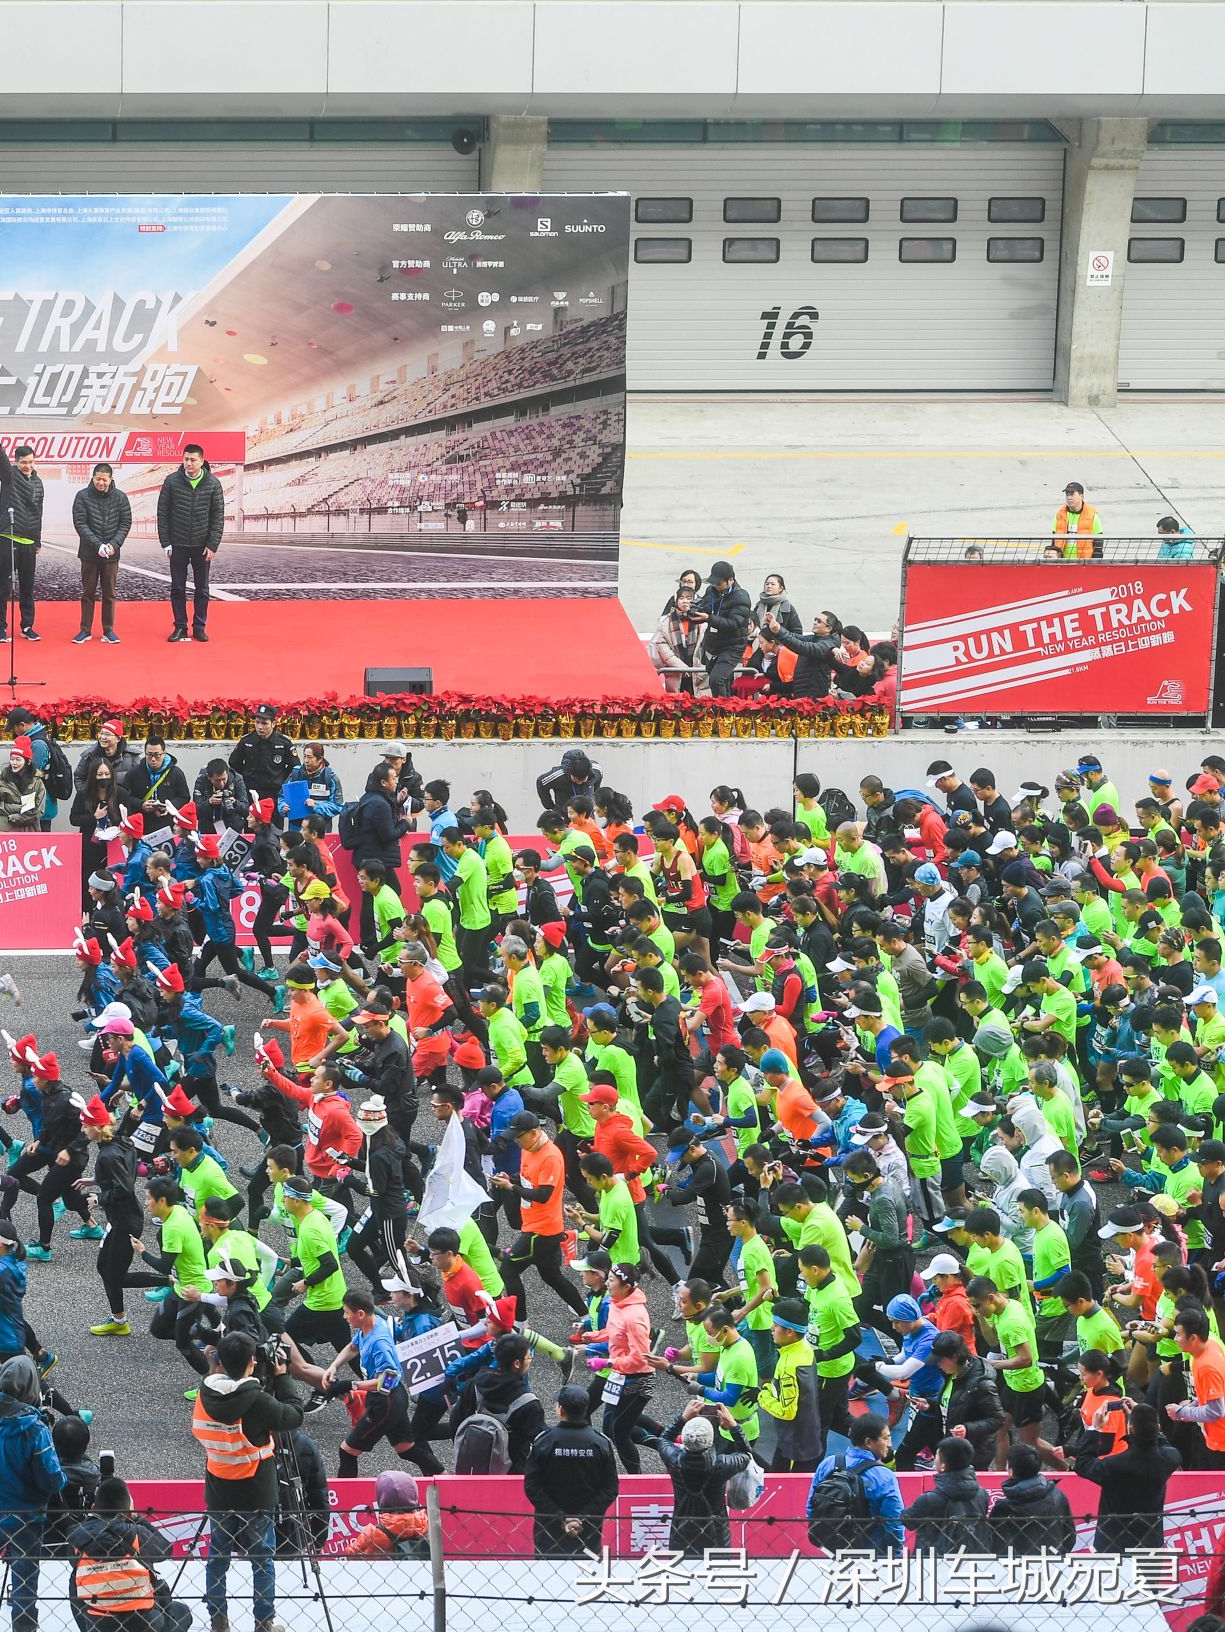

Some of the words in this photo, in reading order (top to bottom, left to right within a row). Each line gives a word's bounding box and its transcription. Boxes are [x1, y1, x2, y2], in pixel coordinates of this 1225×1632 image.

[443, 230, 468, 244] Alfa
[468, 229, 506, 241] Romeo
[564, 224, 606, 233] SUUNTO
[12, 291, 197, 353] TRACK
[756, 305, 820, 360] 16
[0, 435, 117, 460] RESOLUTION
[1110, 580, 1144, 600] 2018
[950, 627, 1013, 665] RUN
[1018, 612, 1083, 647] THE
[1088, 588, 1193, 632] TRACK
[1040, 641, 1066, 657] NEW
[1067, 636, 1096, 650] YEAR
[1098, 619, 1166, 644] RESOLUTION
[1088, 630, 1175, 661] 蒸蒸日上迎新跑
[630, 1503, 675, 1553] 嘉
